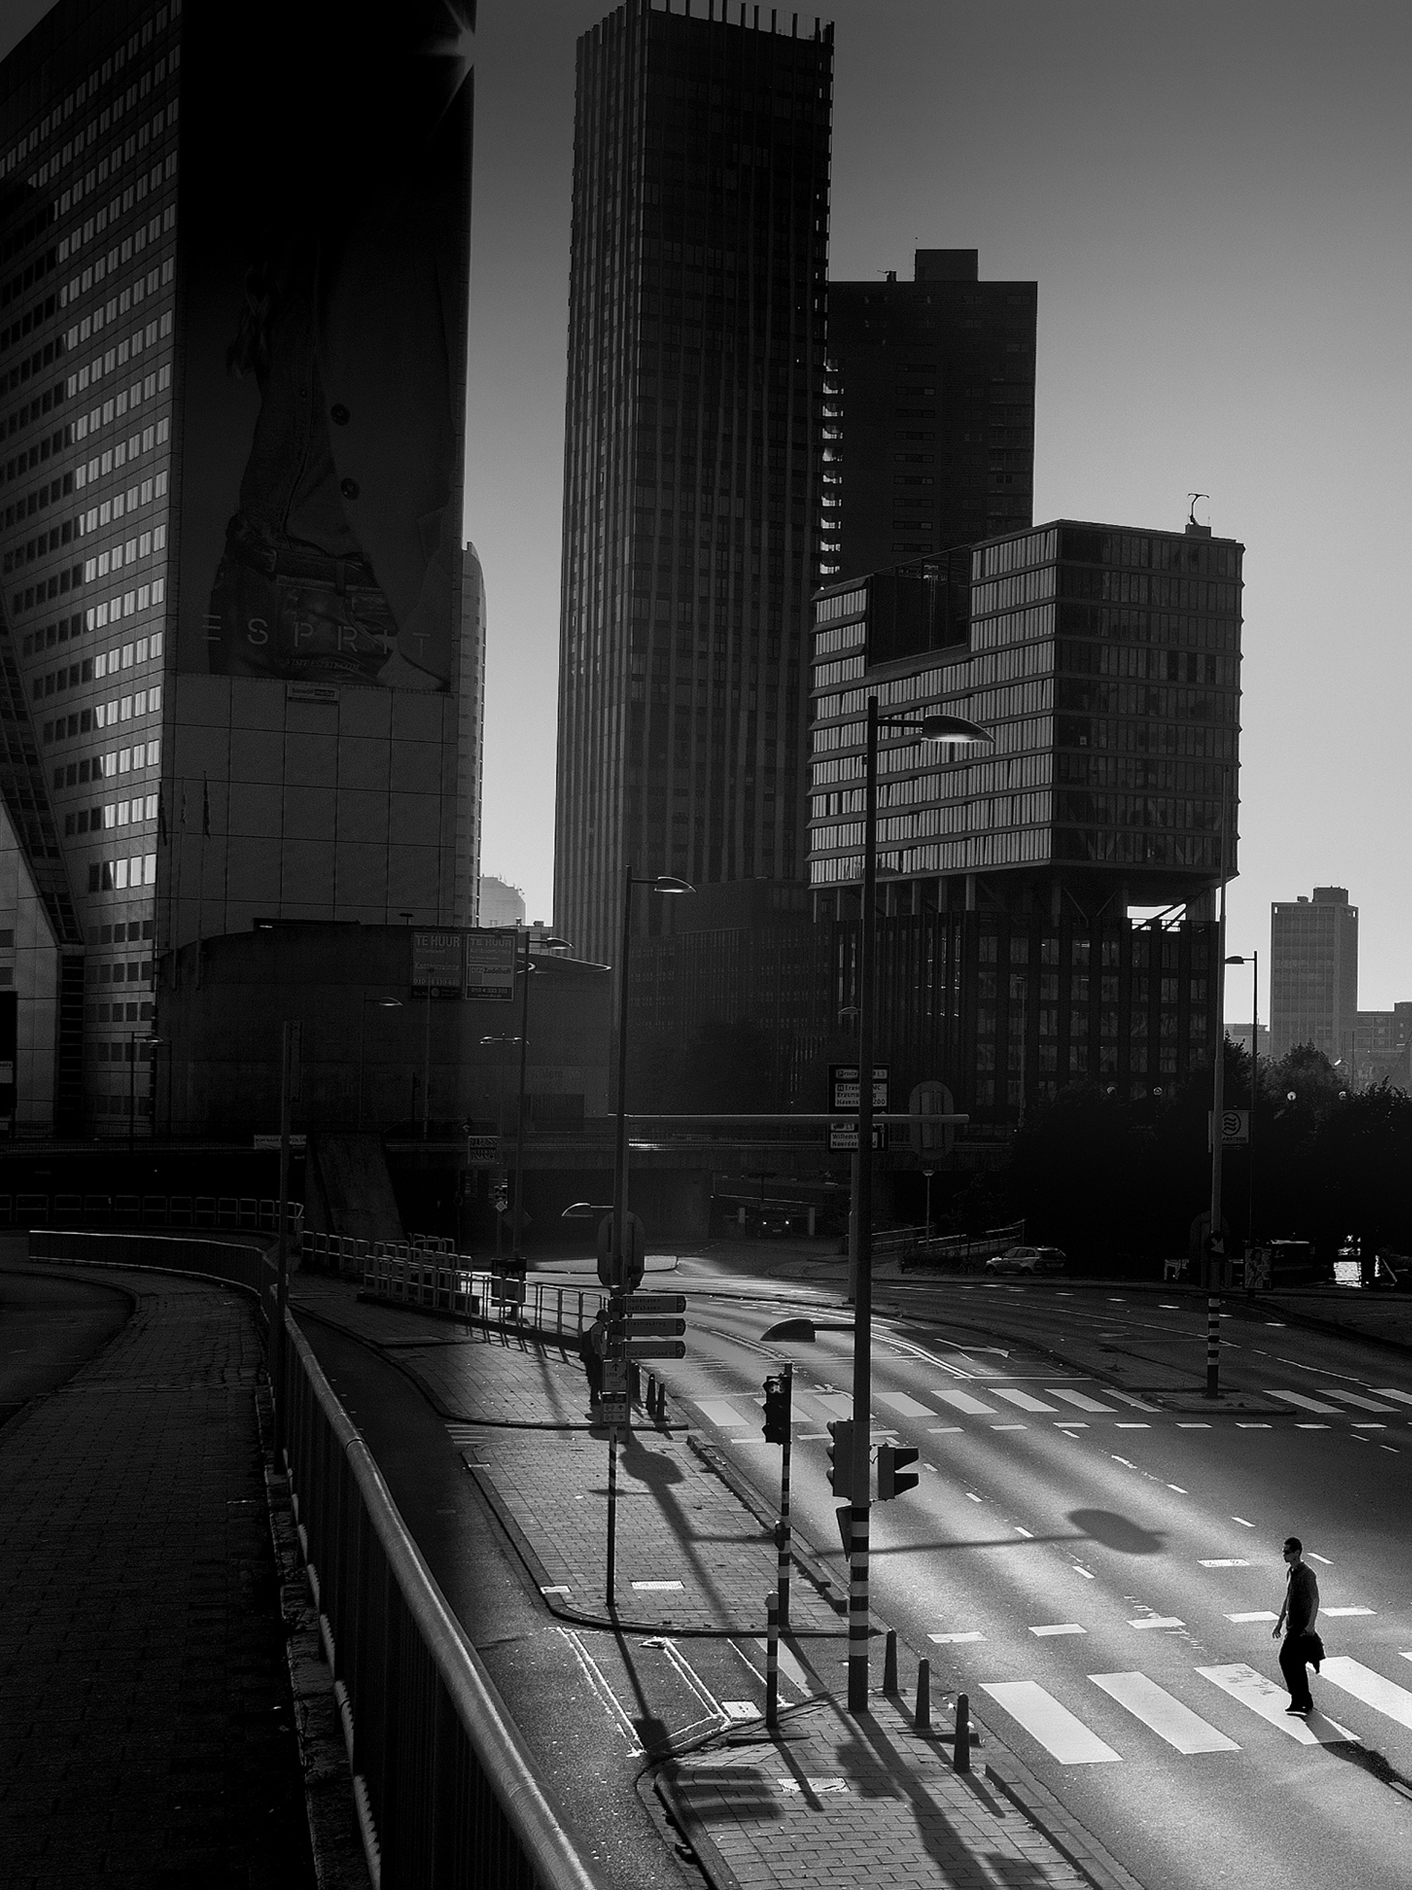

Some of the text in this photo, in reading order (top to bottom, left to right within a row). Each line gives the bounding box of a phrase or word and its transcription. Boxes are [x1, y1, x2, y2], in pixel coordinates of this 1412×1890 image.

[202, 614, 432, 658] ESPRIT
[415, 935, 460, 948] TE HUUR
[470, 938, 512, 948] TE HUUR
